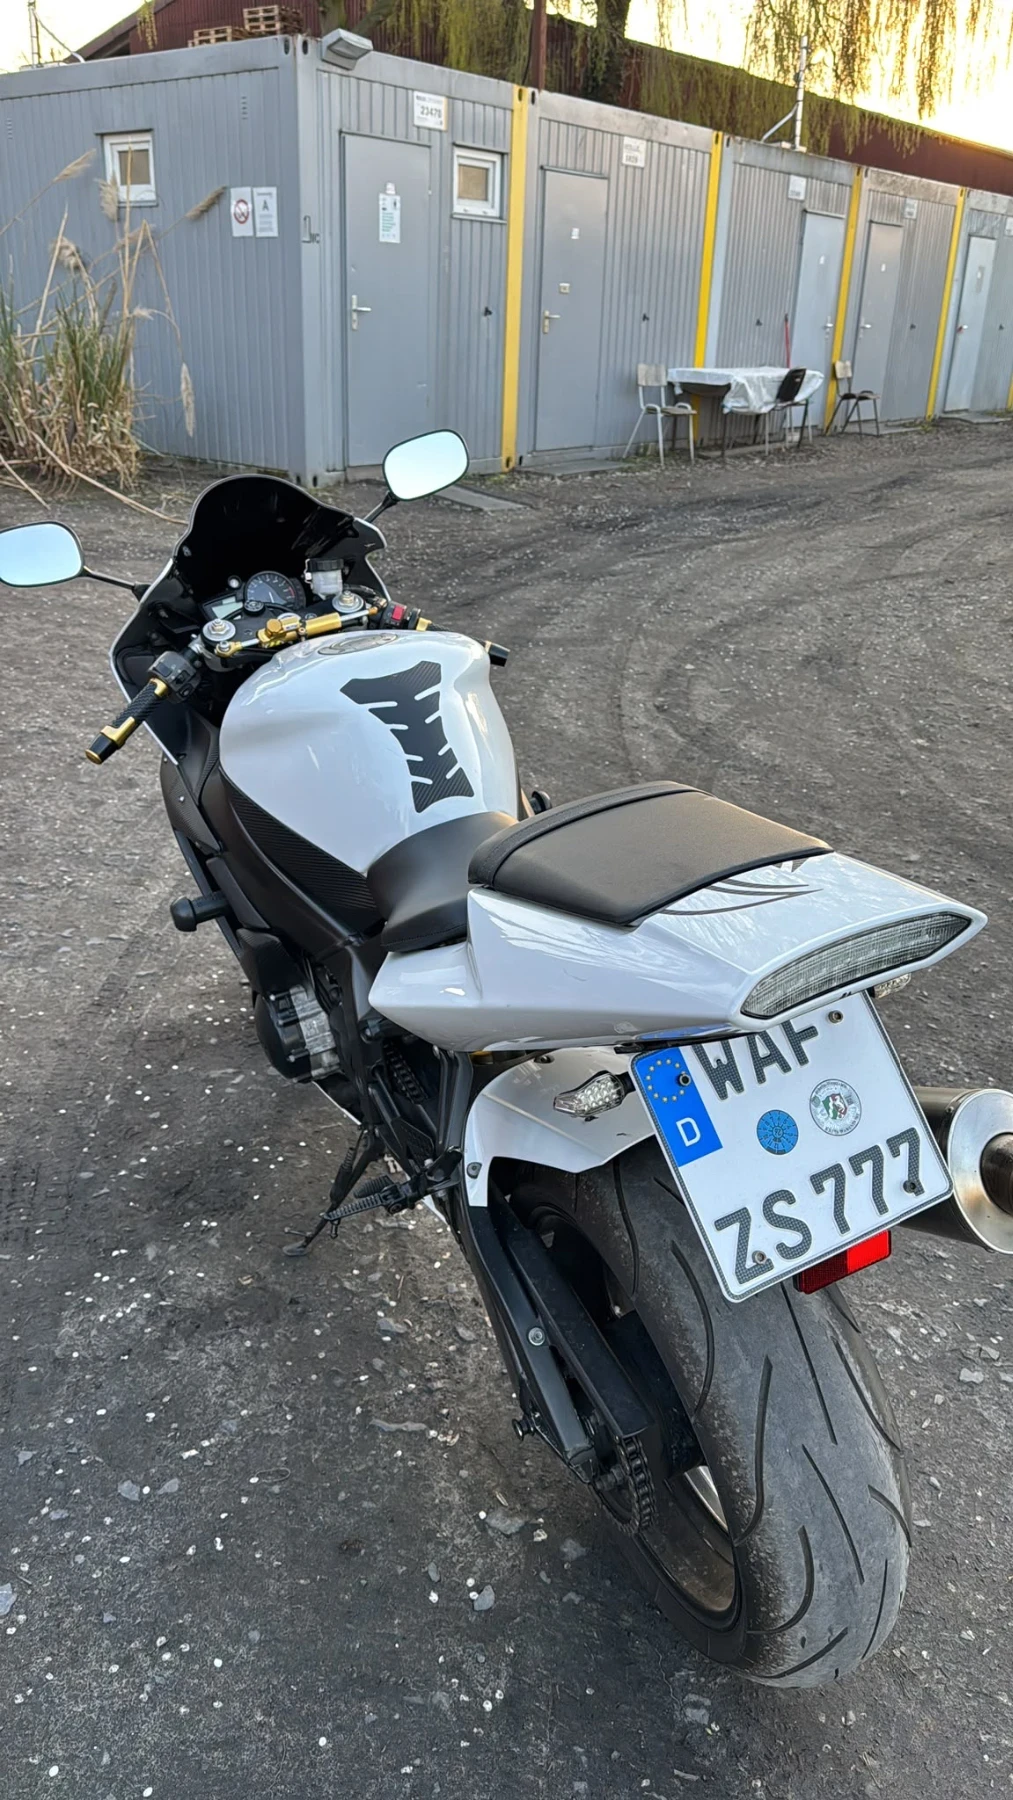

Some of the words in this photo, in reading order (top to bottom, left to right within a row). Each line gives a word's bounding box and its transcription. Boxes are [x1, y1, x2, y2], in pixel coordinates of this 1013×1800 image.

[691, 1019, 820, 1101] WAF
[675, 1116, 701, 1148] D
[713, 1188, 813, 1285] ZS
[809, 1126, 926, 1235] 777
